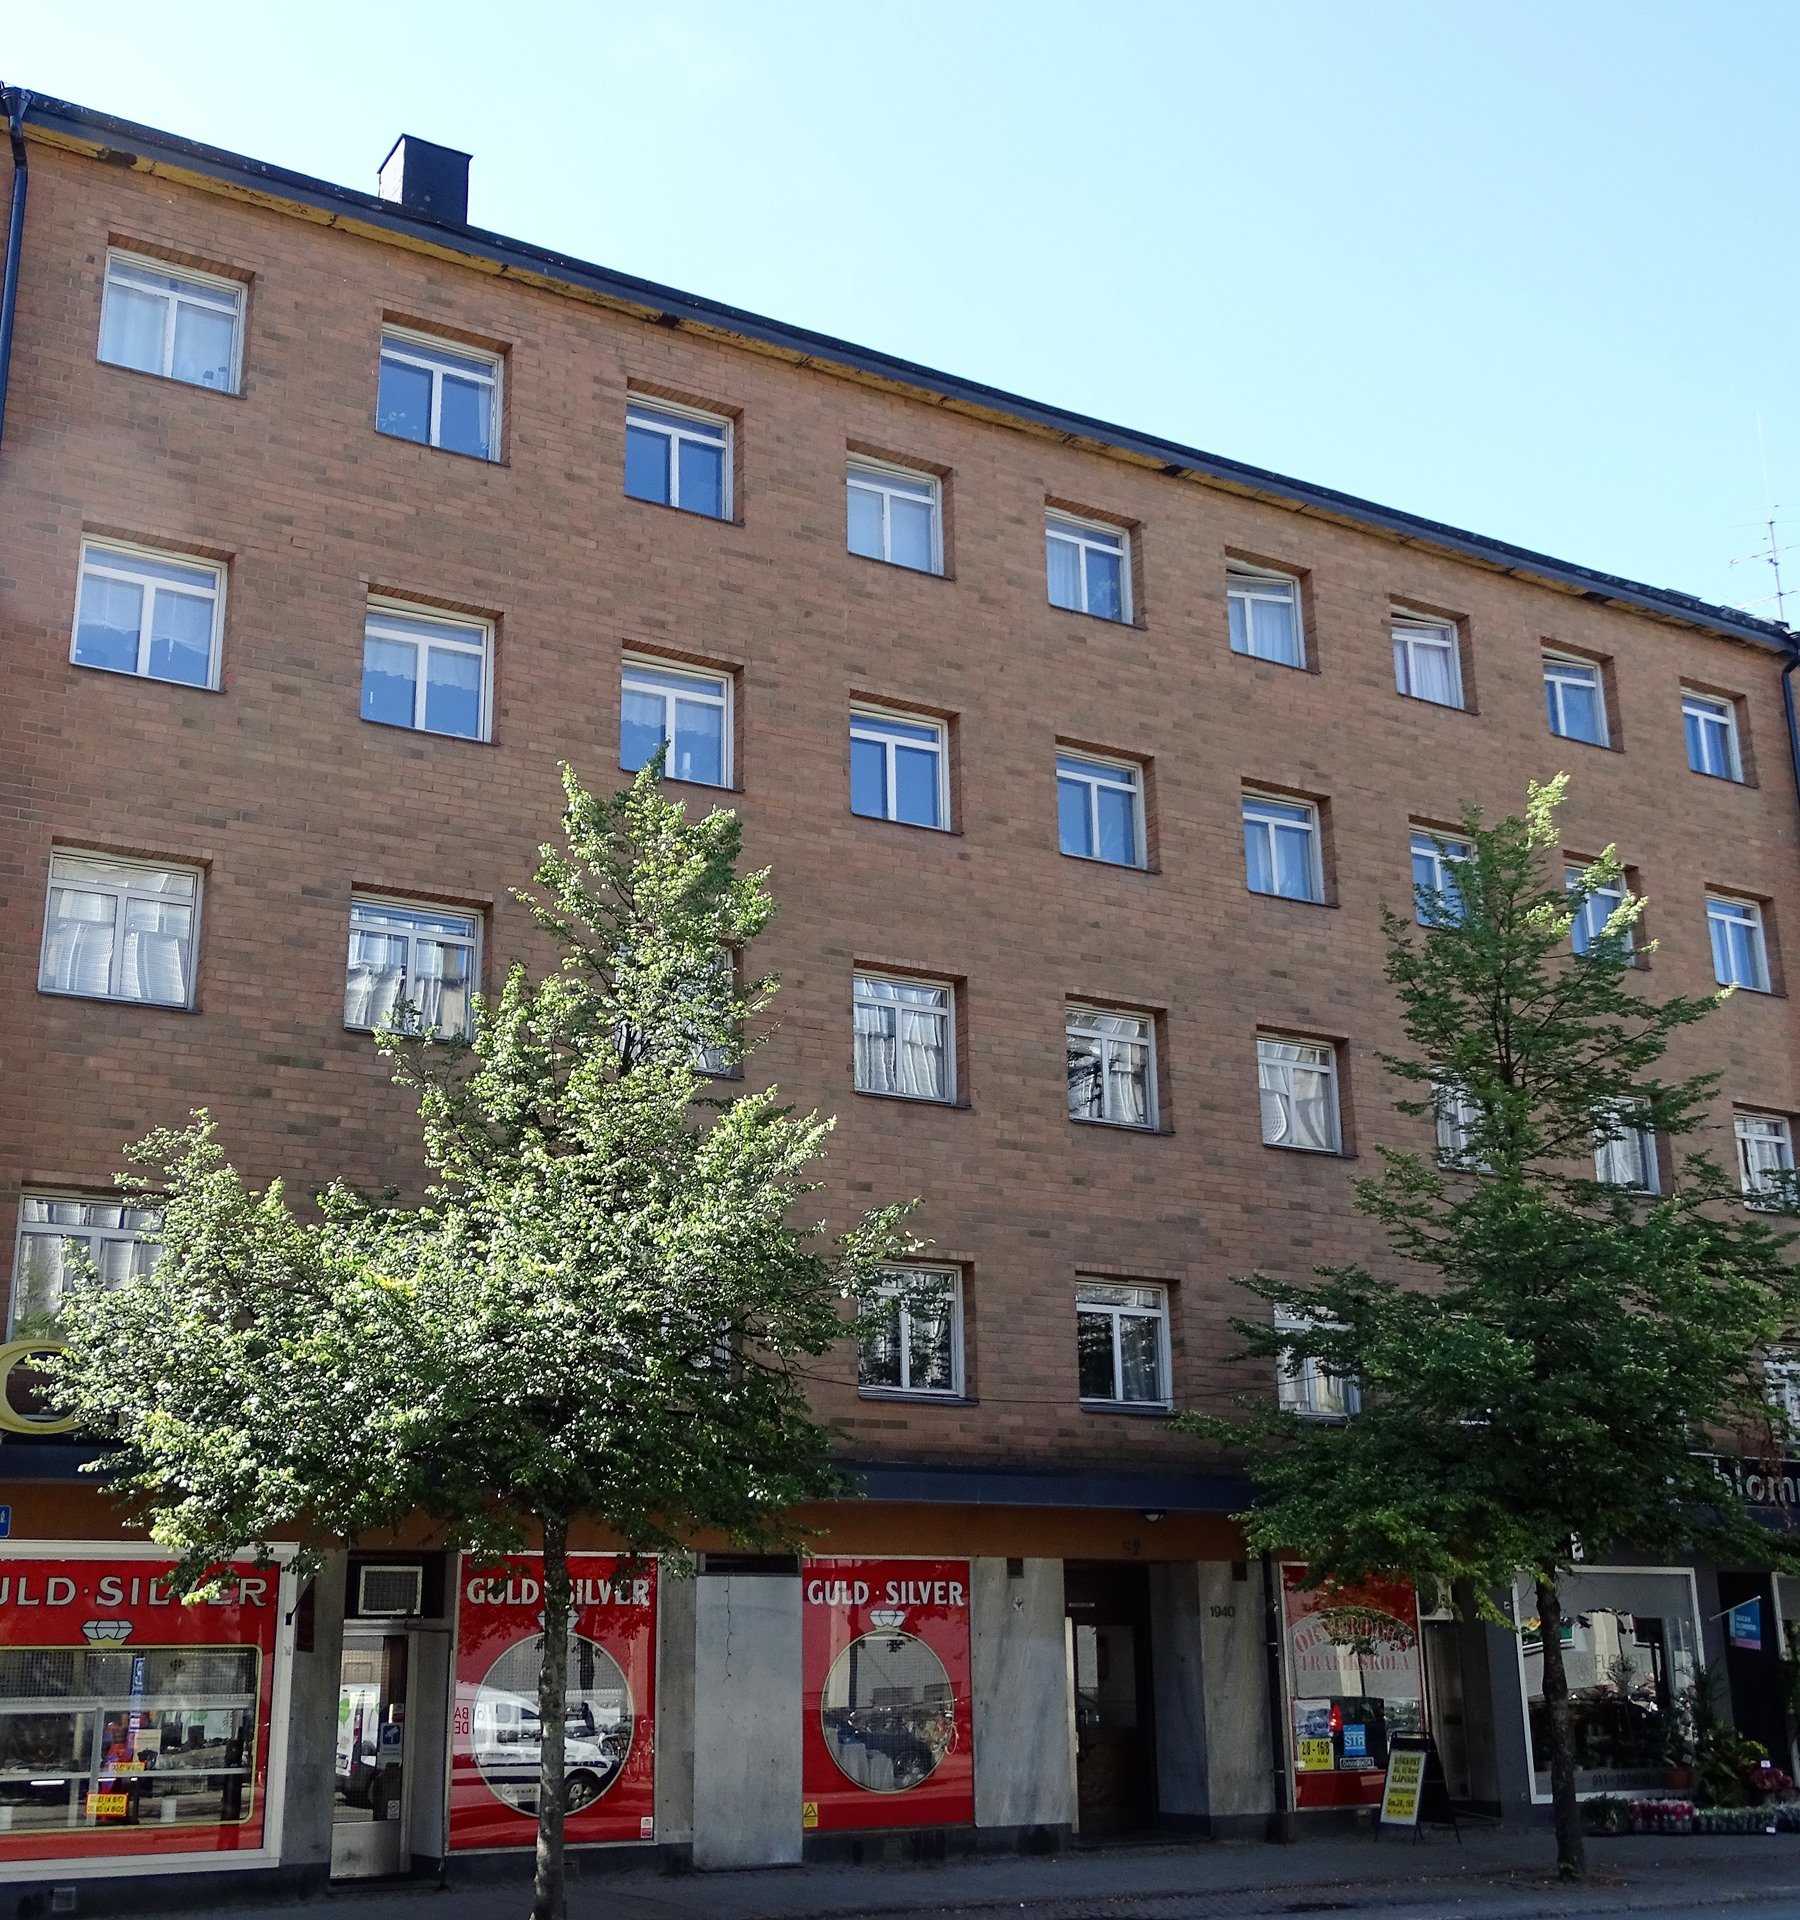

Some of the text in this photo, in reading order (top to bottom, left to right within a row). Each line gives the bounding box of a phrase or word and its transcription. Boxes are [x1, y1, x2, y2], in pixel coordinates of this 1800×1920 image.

[96, 1576, 268, 1607] SILR
[466, 1577, 540, 1605] GULD
[807, 1579, 965, 1606] GULD SILVER
[1209, 1605, 1235, 1618] 1940
